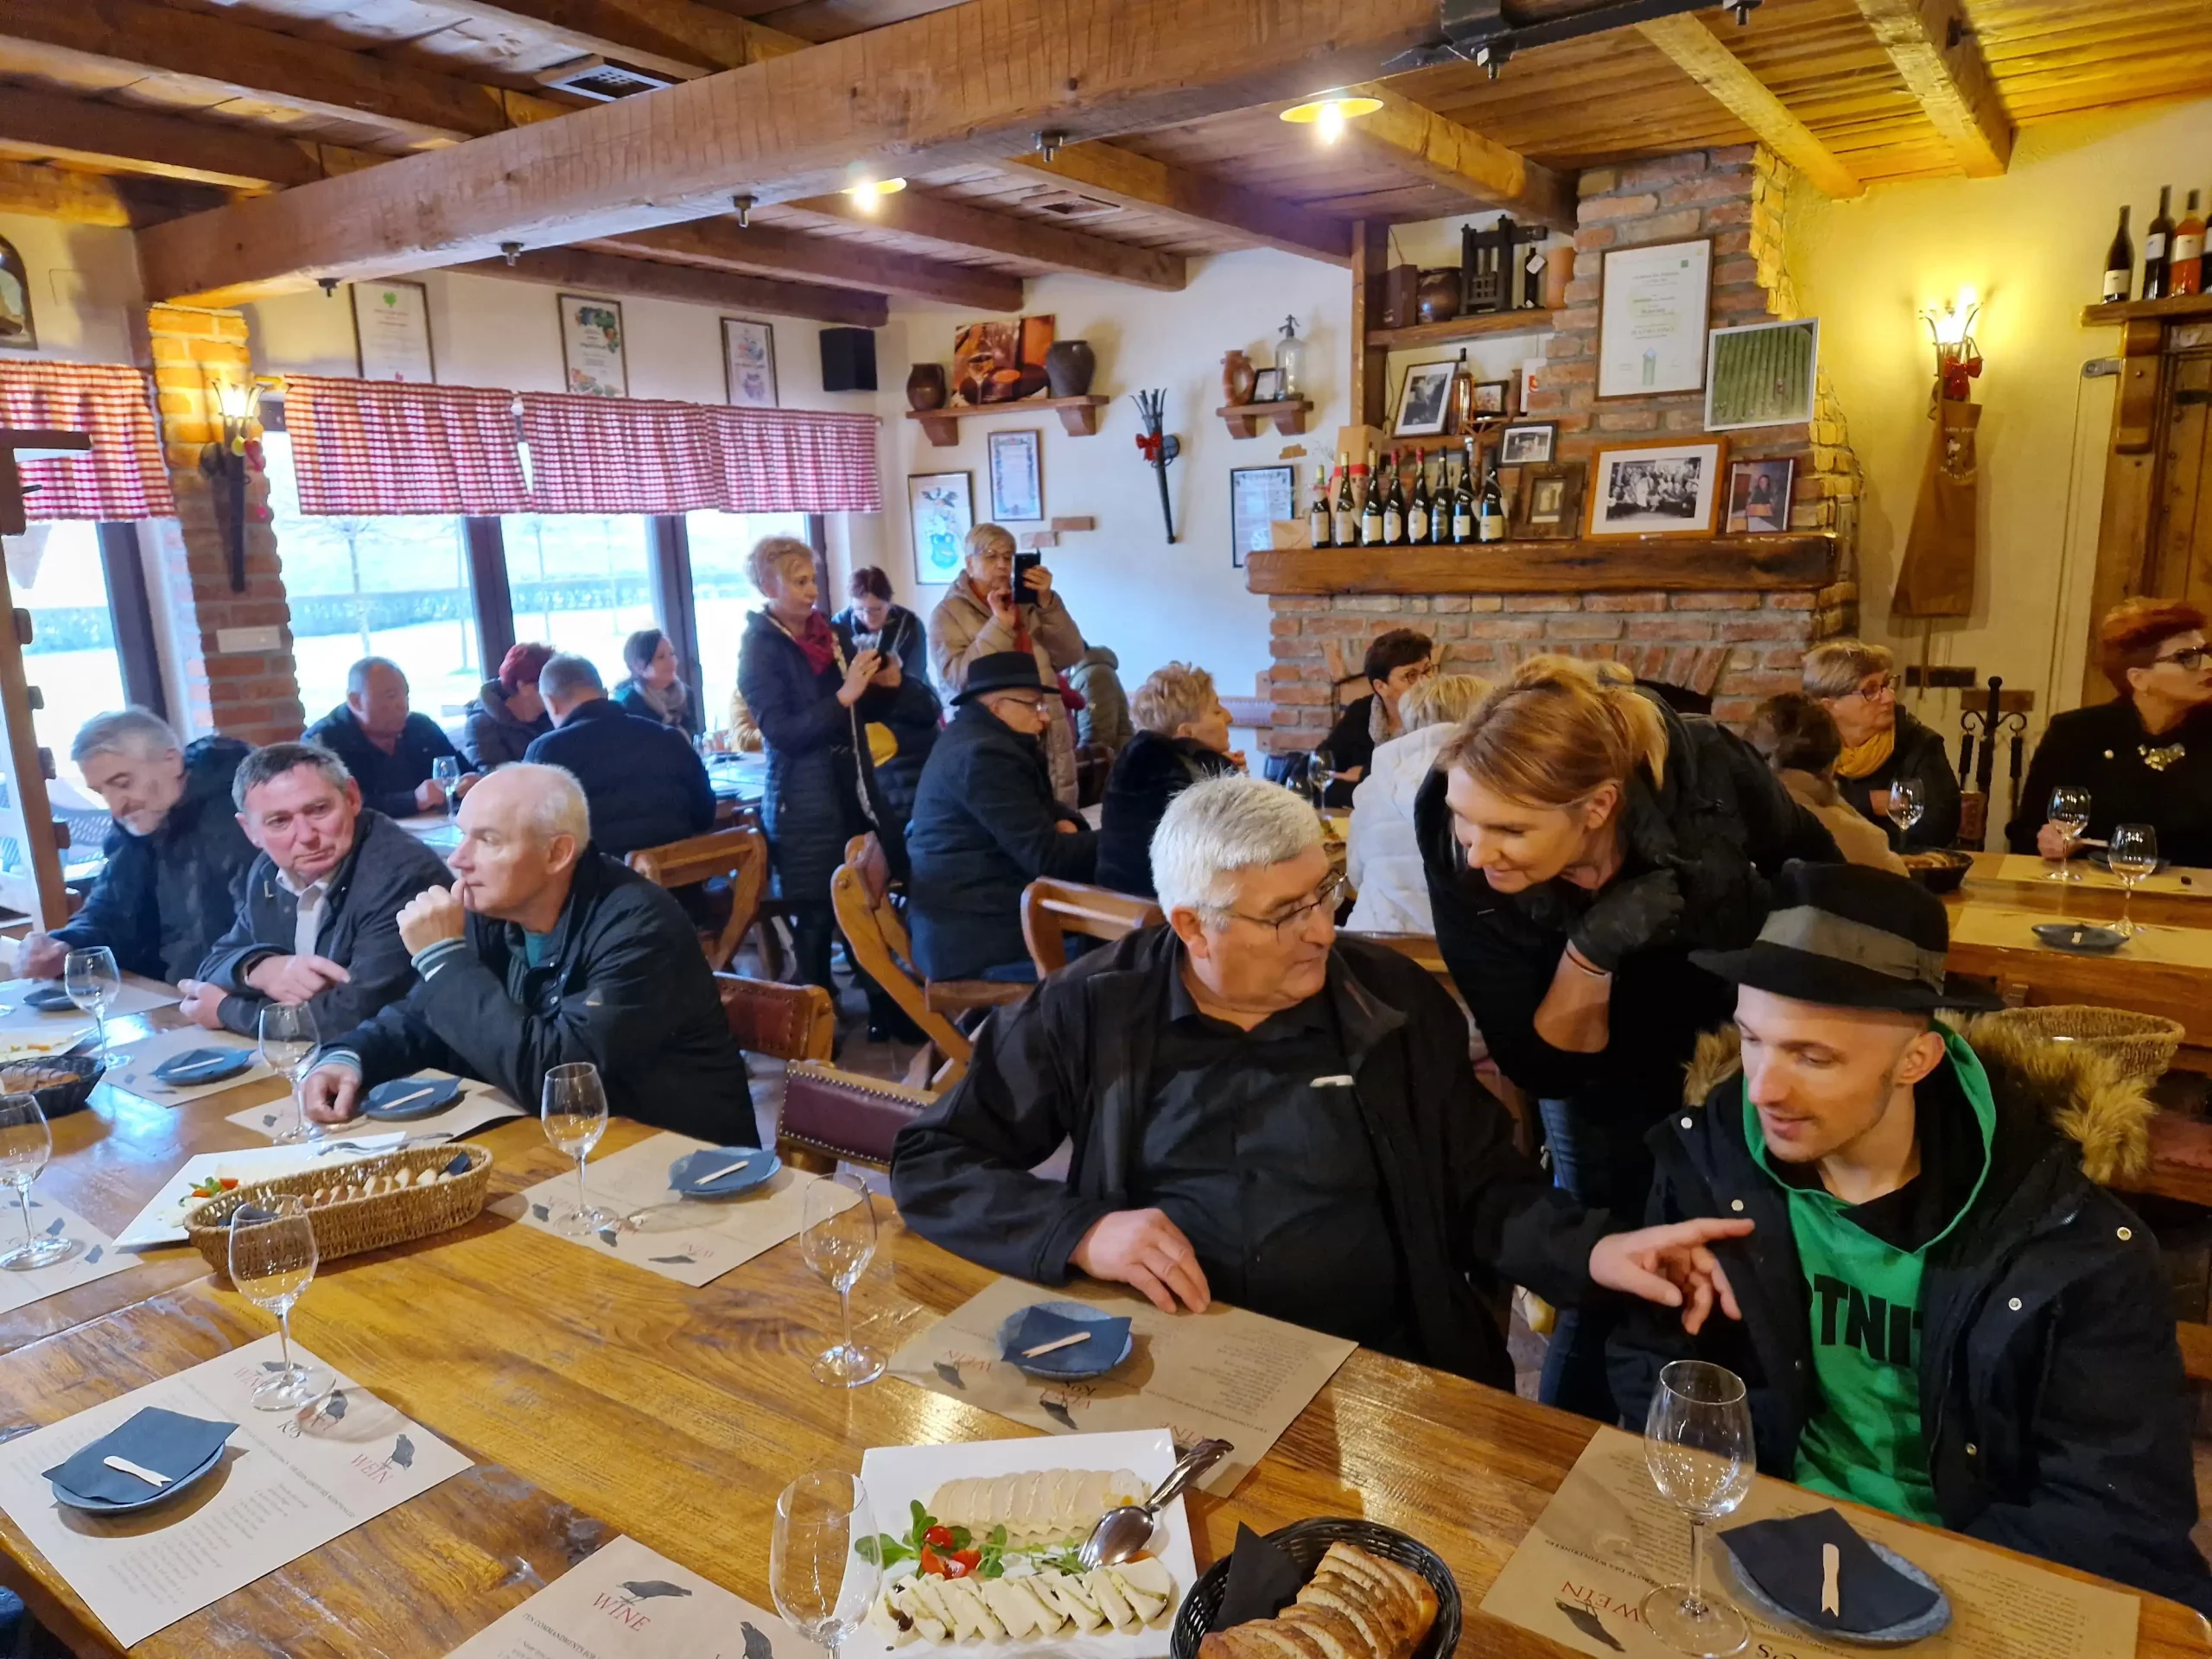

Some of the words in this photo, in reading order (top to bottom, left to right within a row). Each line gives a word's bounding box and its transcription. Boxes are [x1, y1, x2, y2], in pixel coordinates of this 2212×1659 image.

[1814, 1274, 1923, 1367] TNI
[593, 1592, 652, 1632] WINE
[1560, 1580, 1640, 1623] WEIN
